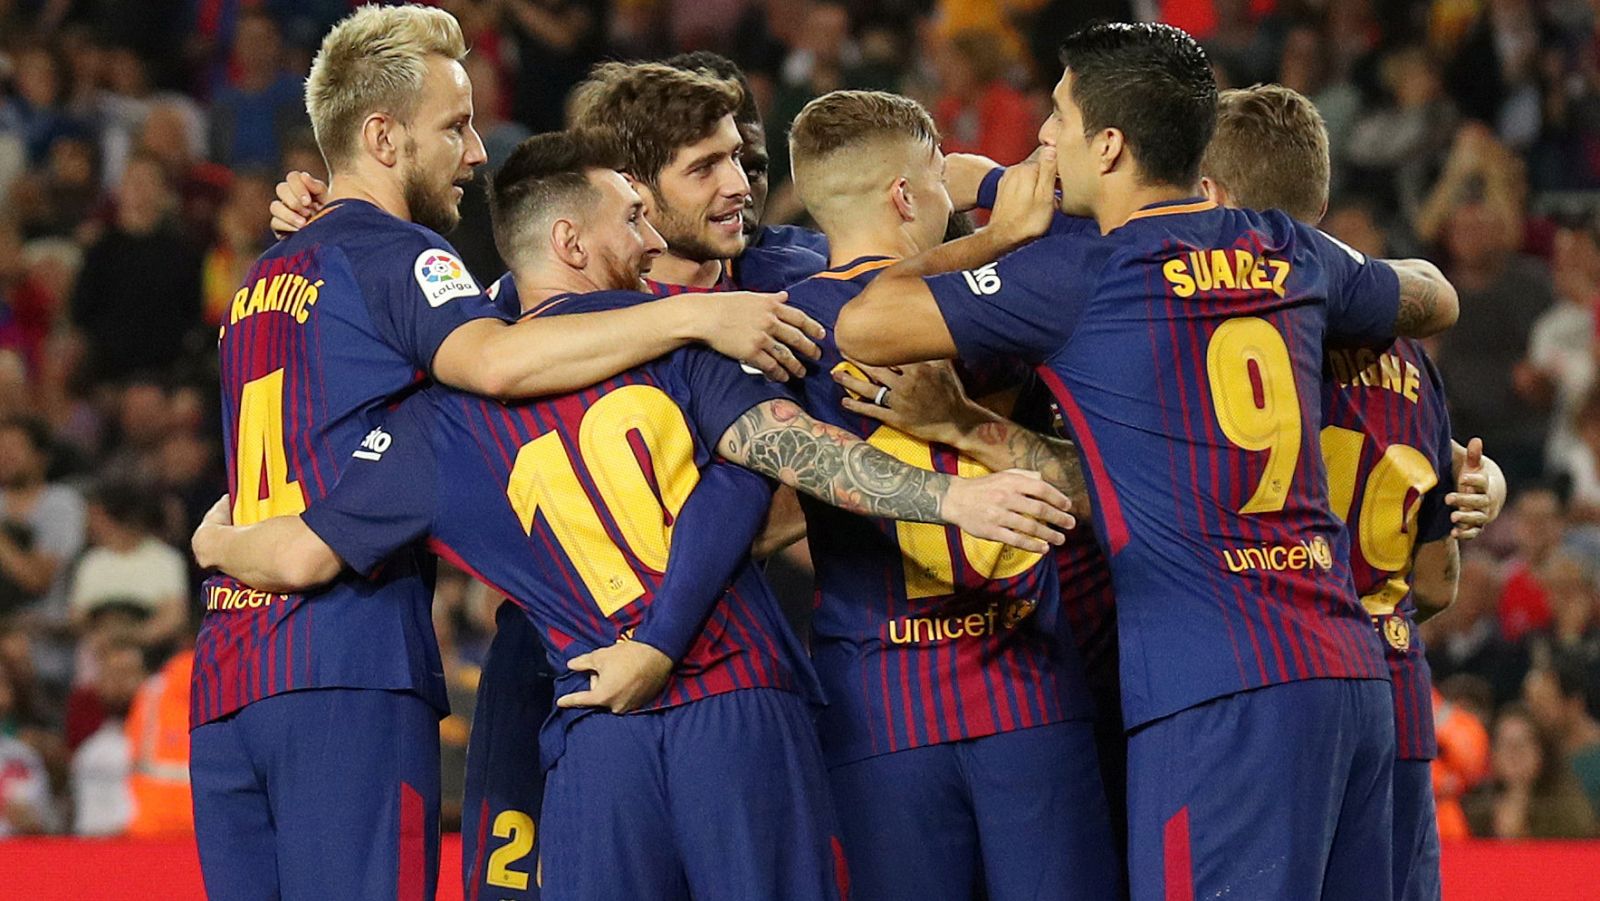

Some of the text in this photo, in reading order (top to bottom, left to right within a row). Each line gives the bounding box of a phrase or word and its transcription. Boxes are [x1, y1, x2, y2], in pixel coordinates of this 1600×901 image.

[230, 273, 325, 325] RAKITIĆ
[432, 281, 472, 299] LaLiga
[1162, 249, 1290, 299] SUAREZ
[232, 367, 306, 526] 4
[1206, 316, 1302, 514] 9
[506, 384, 700, 617] 10
[889, 603, 998, 644] unicef
[486, 809, 542, 888] 2
